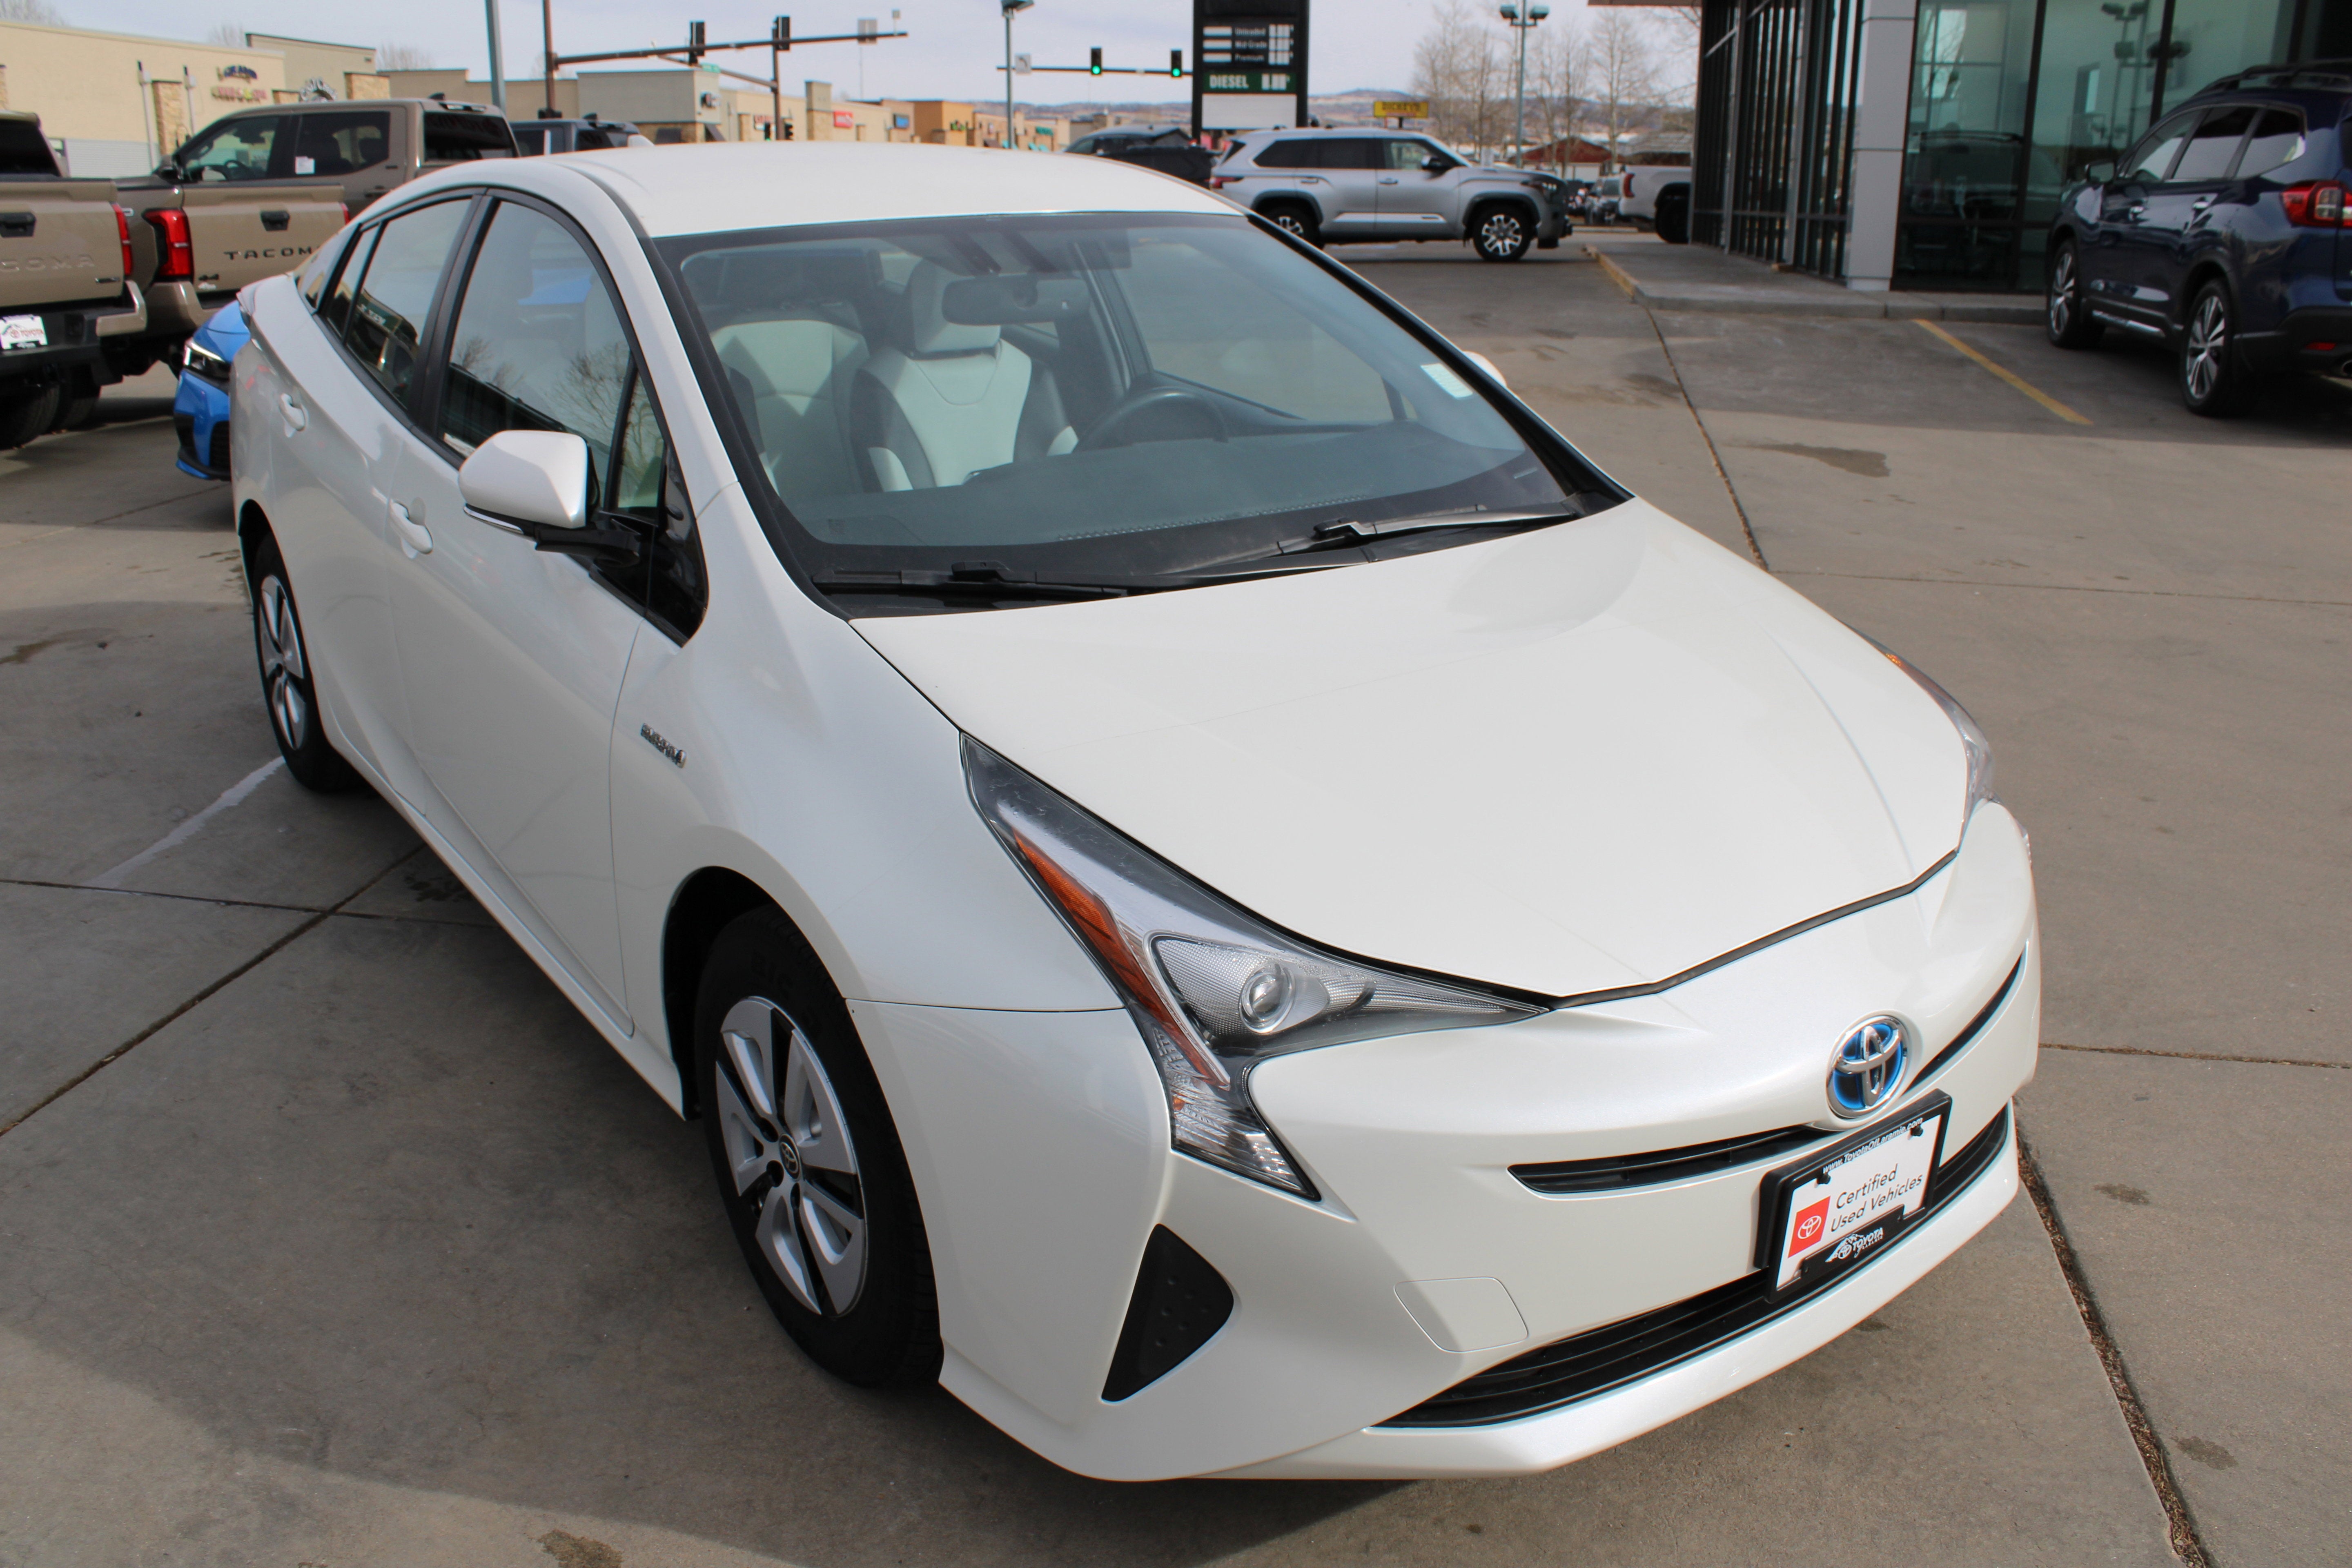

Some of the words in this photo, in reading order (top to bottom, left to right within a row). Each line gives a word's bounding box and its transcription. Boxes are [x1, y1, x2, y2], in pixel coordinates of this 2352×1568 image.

[1209, 74, 1250, 89] DIESEL
[223, 245, 320, 261] TACOM
[1836, 1163, 1898, 1209] Certified
[1831, 1200, 1867, 1232] Used
[1871, 1174, 1923, 1211] Vehicles
[1853, 1227, 1884, 1252] TOYOTA
